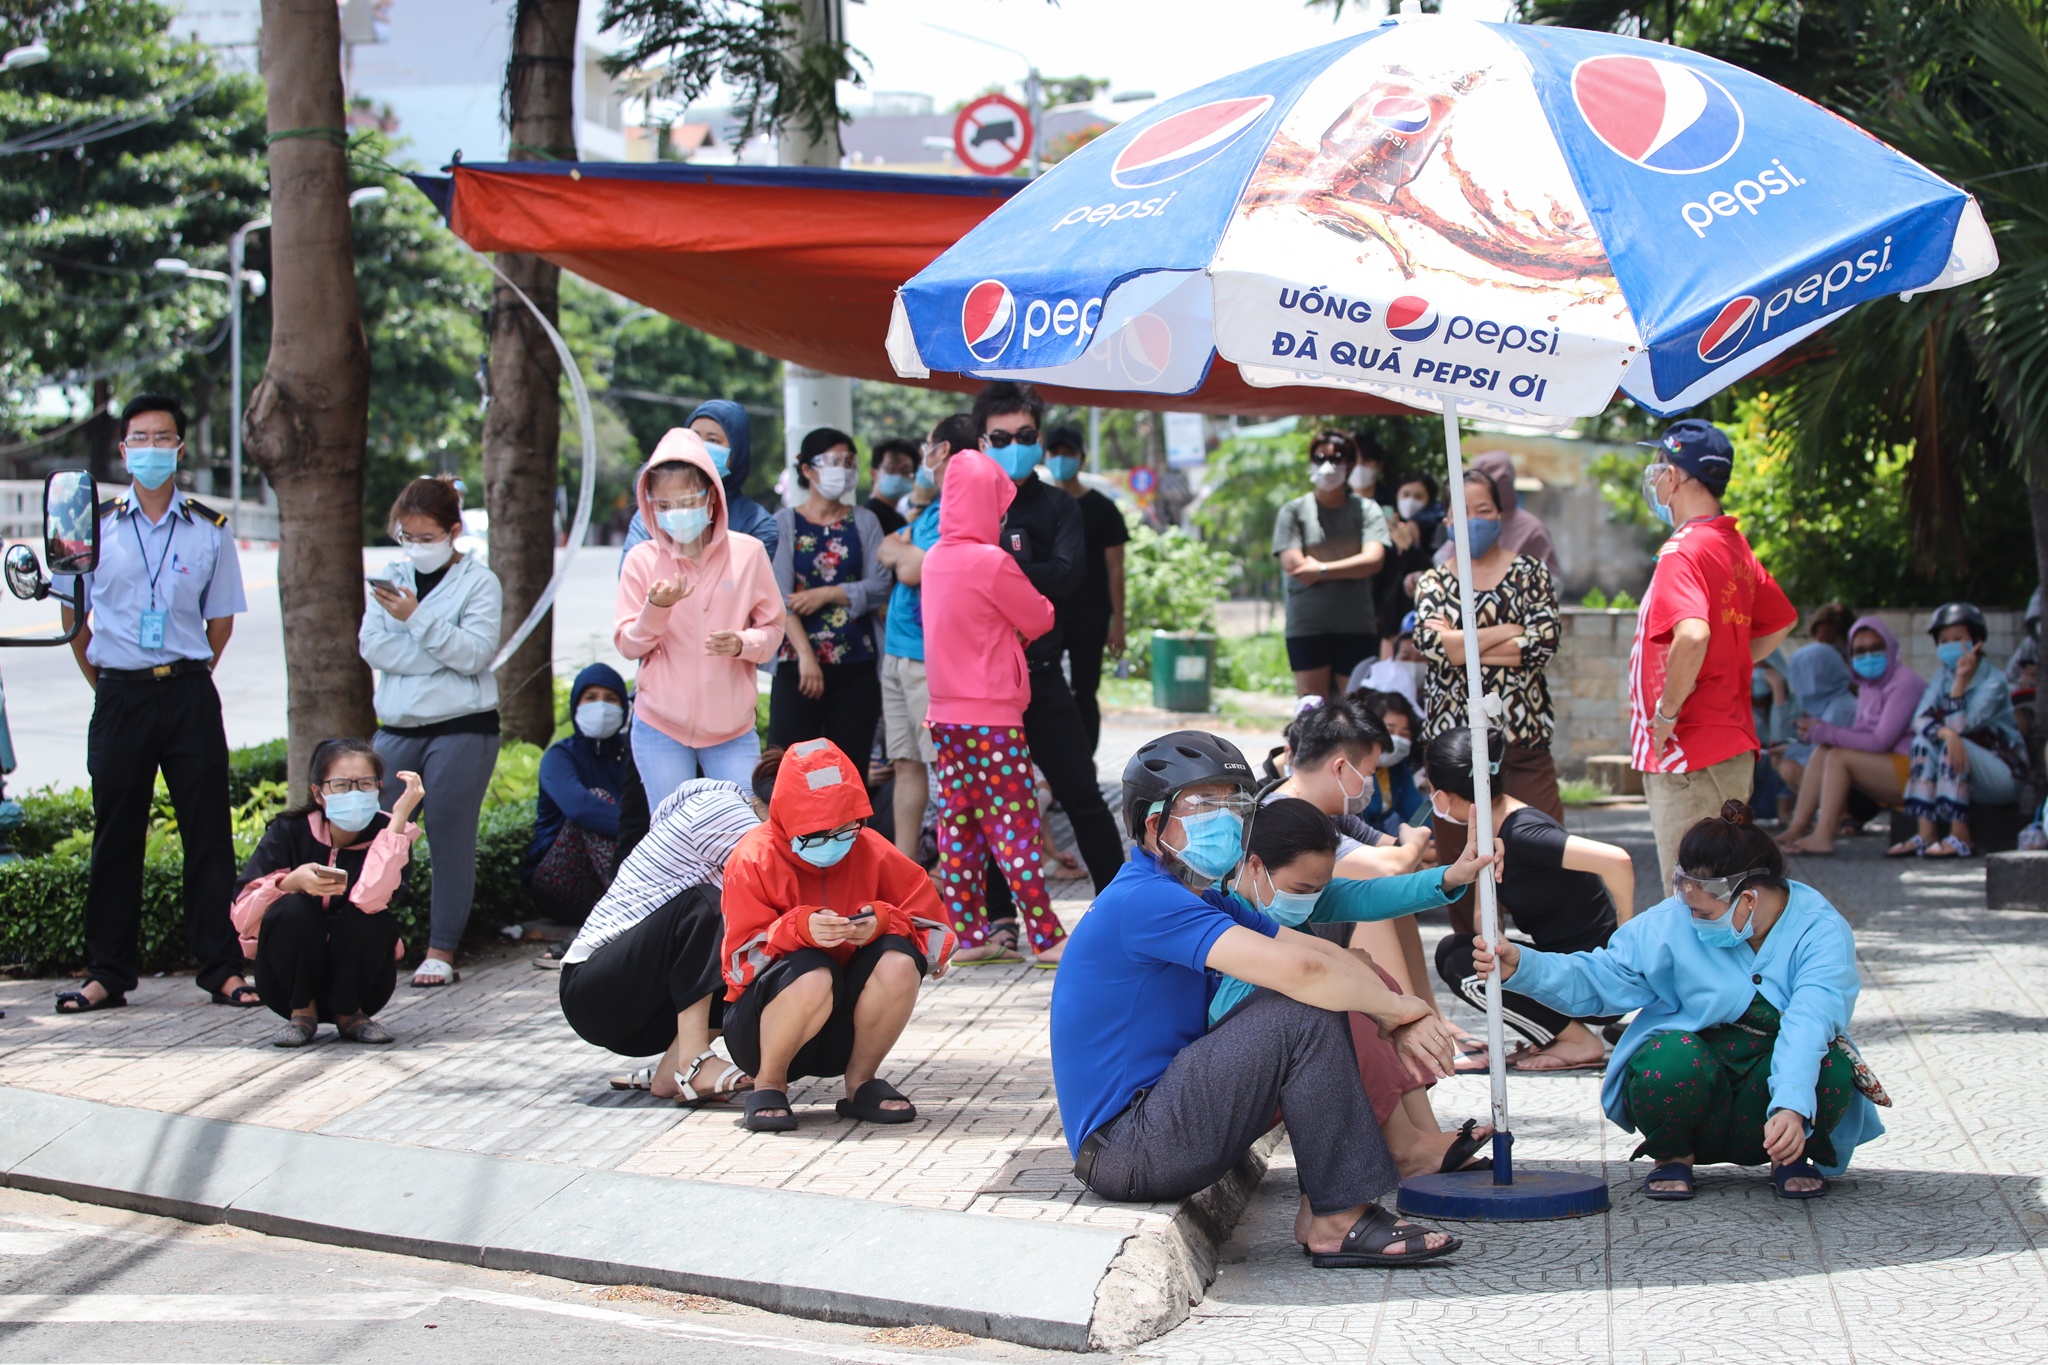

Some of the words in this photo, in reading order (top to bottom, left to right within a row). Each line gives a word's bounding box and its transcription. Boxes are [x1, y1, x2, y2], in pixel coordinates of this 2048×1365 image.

[1050, 190, 1178, 232] pepsi
[1681, 158, 1807, 239] pepsi
[1762, 235, 1893, 332] pepsi
[1022, 298, 1103, 350] pep
[1279, 285, 1372, 323] UỐNG
[1443, 315, 1561, 356] pepsi
[1272, 330, 1319, 361] ĐÃ
[1330, 341, 1402, 374] QUÁ
[1413, 358, 1500, 391] PEPSI
[1509, 374, 1548, 402] ƠI
